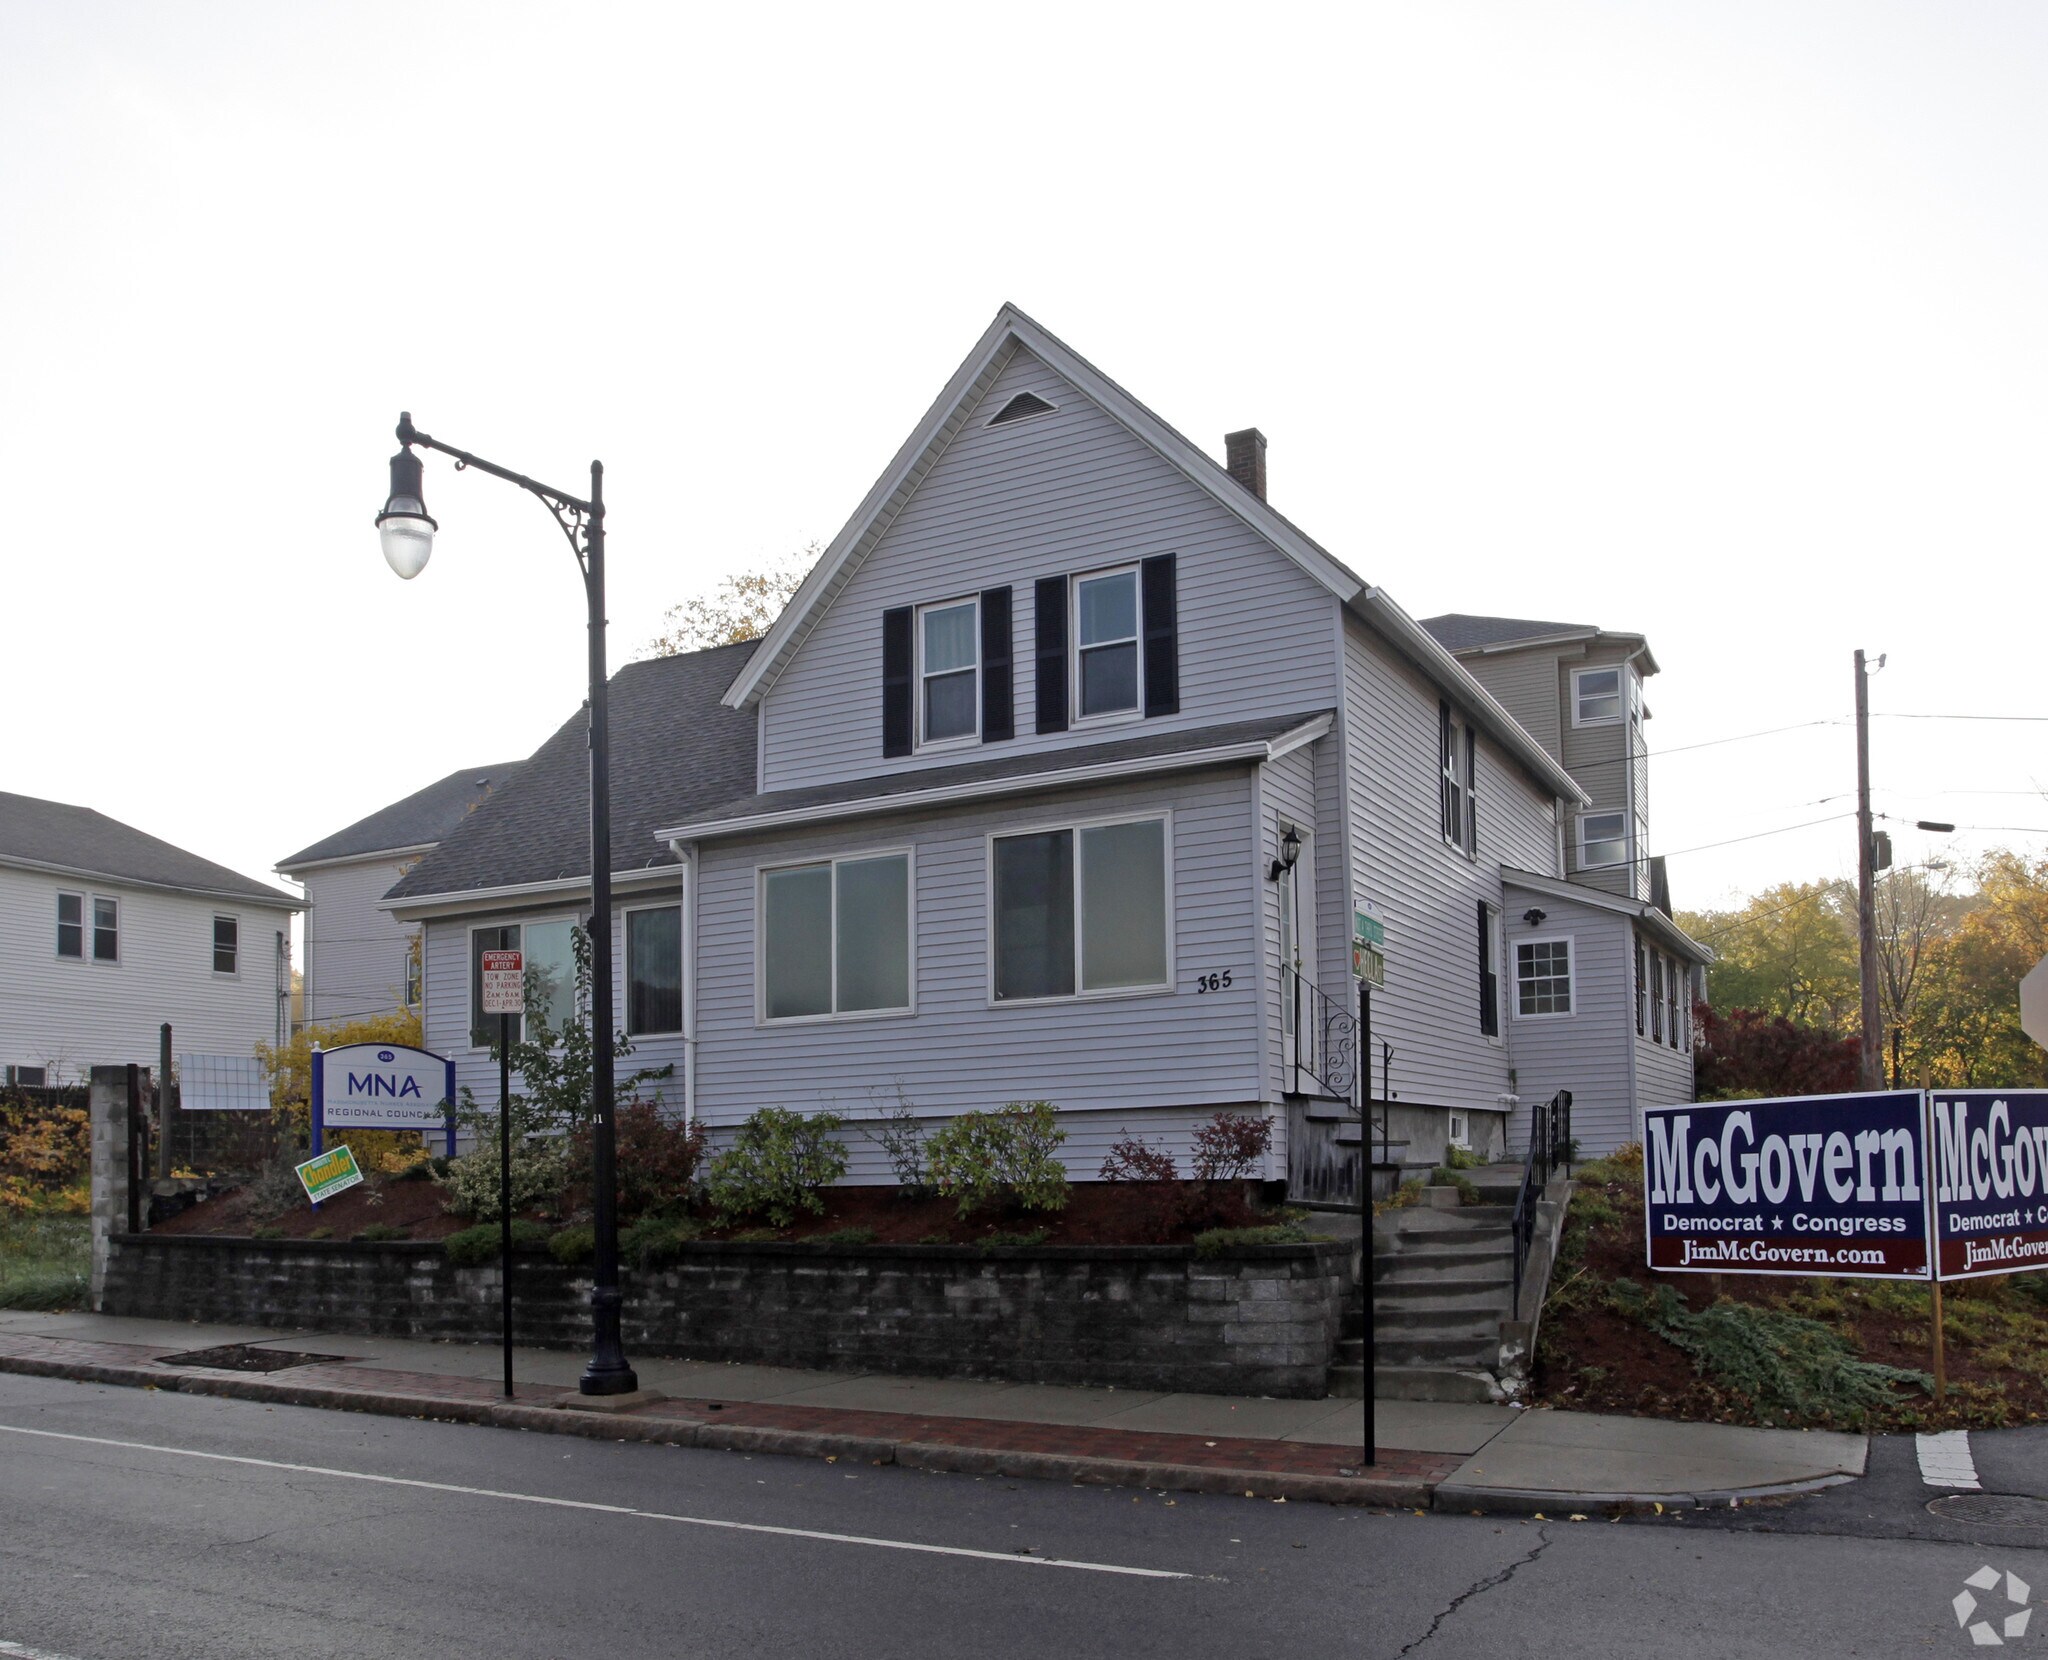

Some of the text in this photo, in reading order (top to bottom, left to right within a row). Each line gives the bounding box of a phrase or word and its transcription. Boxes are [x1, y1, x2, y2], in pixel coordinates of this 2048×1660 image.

[485, 981, 521, 990] NO PARKING
[503, 972, 519, 980] ZONE
[1197, 969, 1232, 994] 365
[348, 1072, 422, 1098] MNA
[327, 1107, 383, 1118] REGIONAL
[302, 1153, 352, 1187] Chandler
[1649, 1111, 1920, 1204] McGovern
[313, 1187, 331, 1201] STATE
[332, 1174, 359, 1191] SENATOR
[1663, 1213, 1907, 1236] Democrat Congress
[1950, 1208, 2020, 1233] Democrat
[1680, 1240, 1886, 1266] JimMcGovern.com
